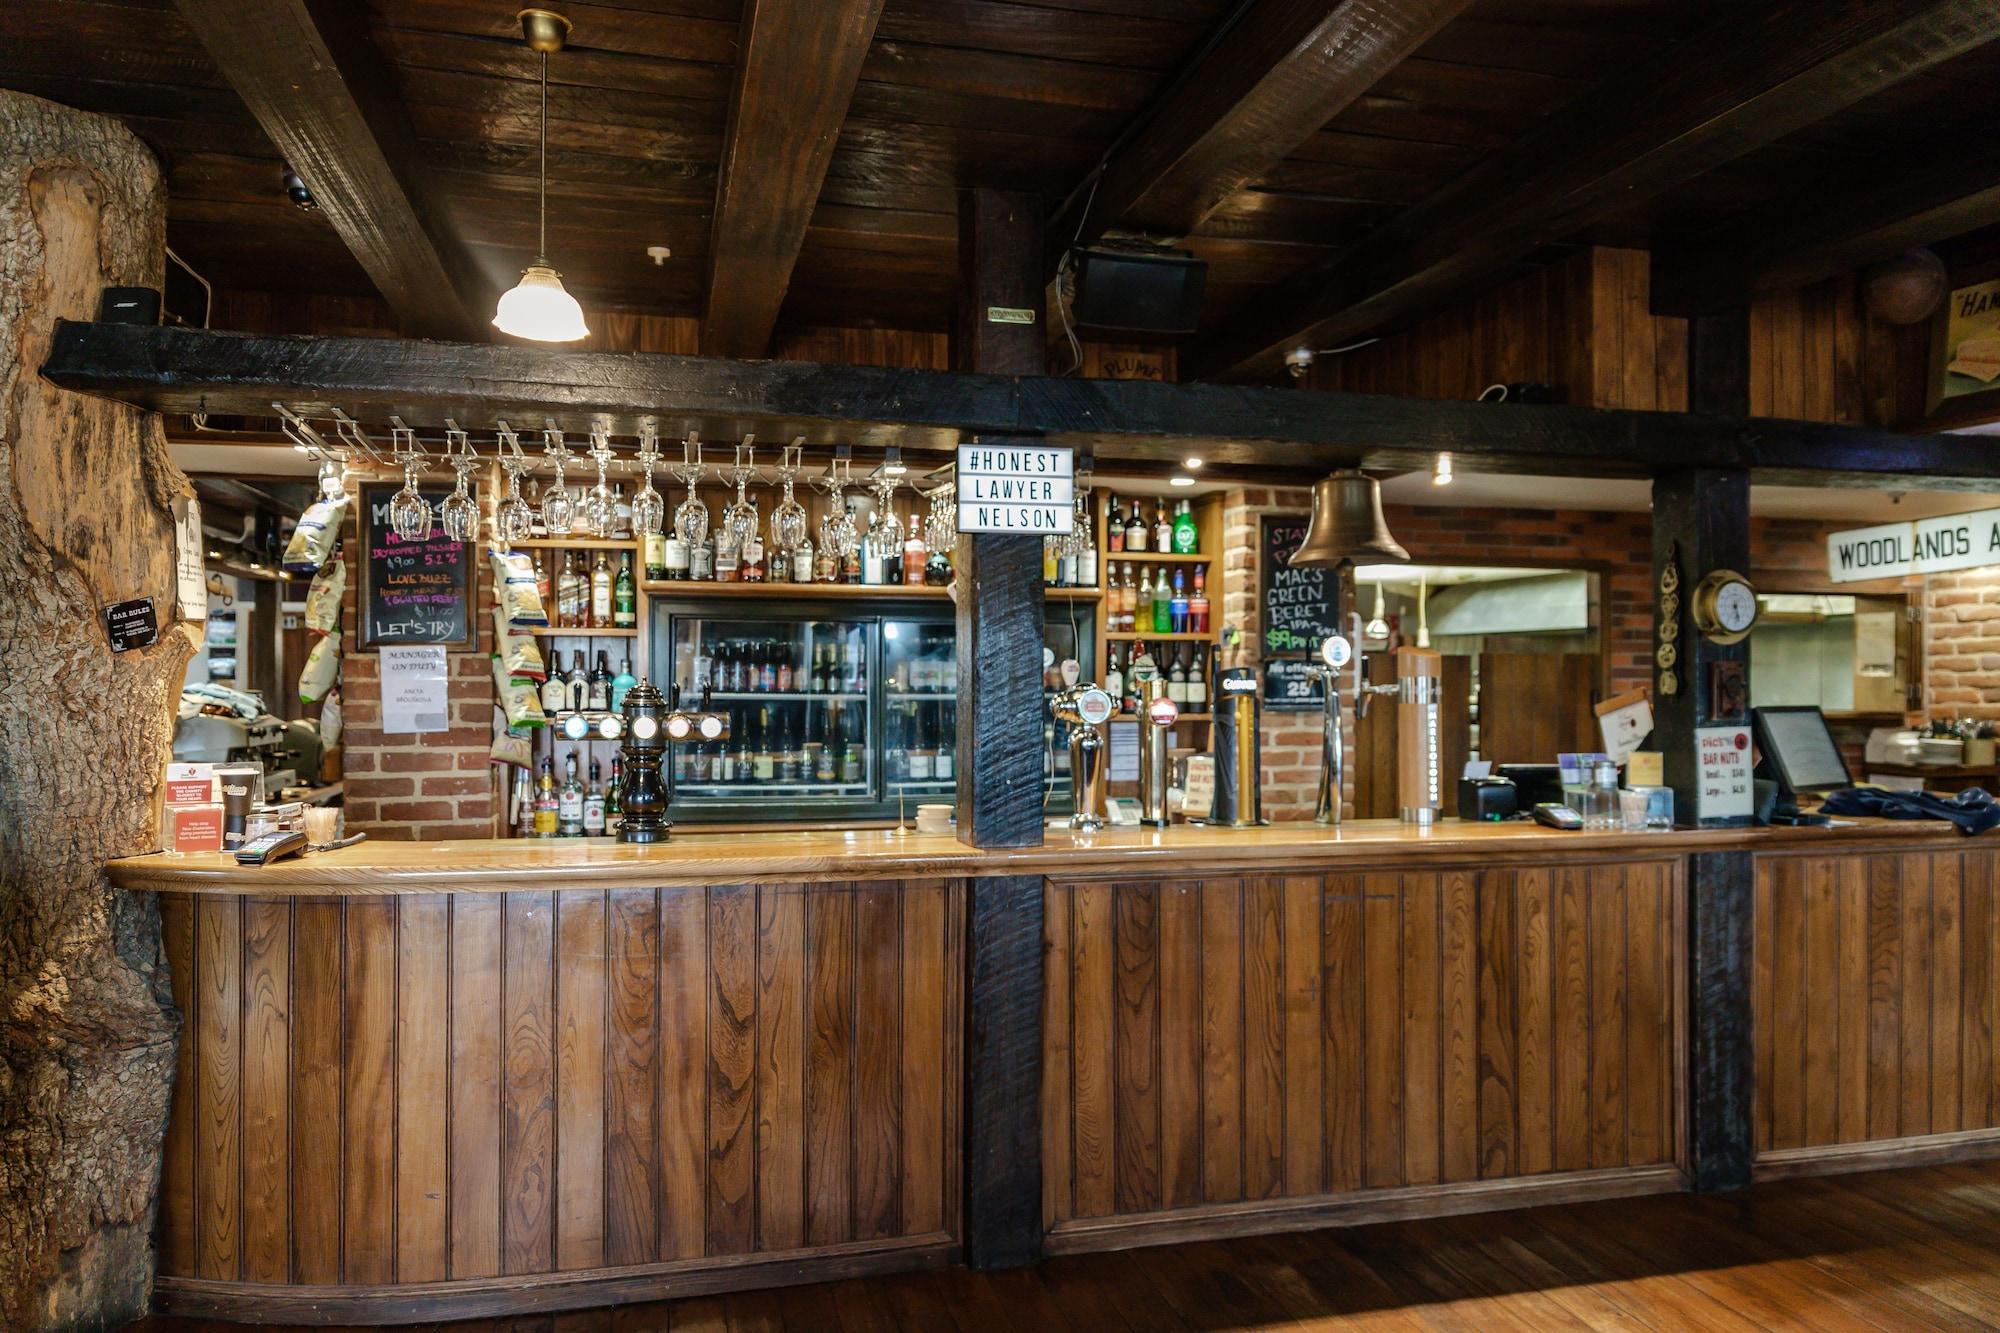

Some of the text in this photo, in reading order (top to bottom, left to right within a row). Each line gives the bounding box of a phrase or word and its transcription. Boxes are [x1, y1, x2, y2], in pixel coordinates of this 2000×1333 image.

[970, 451, 1059, 472] #HONEST
[976, 480, 1052, 500] LAWYER
[979, 507, 1056, 529] NELSON
[1839, 527, 1970, 570] WOODLANDS
[1275, 567, 1326, 587] MAC'S
[1267, 584, 1324, 605] GREEN
[1267, 603, 1329, 625] BERET
[376, 619, 455, 641] LET'S TRY
[388, 651, 440, 660] MANAGER
[392, 662, 437, 671] ON DUTY
[1286, 680, 1311, 697] 25
[1703, 751, 1740, 765] BAR NUTS
